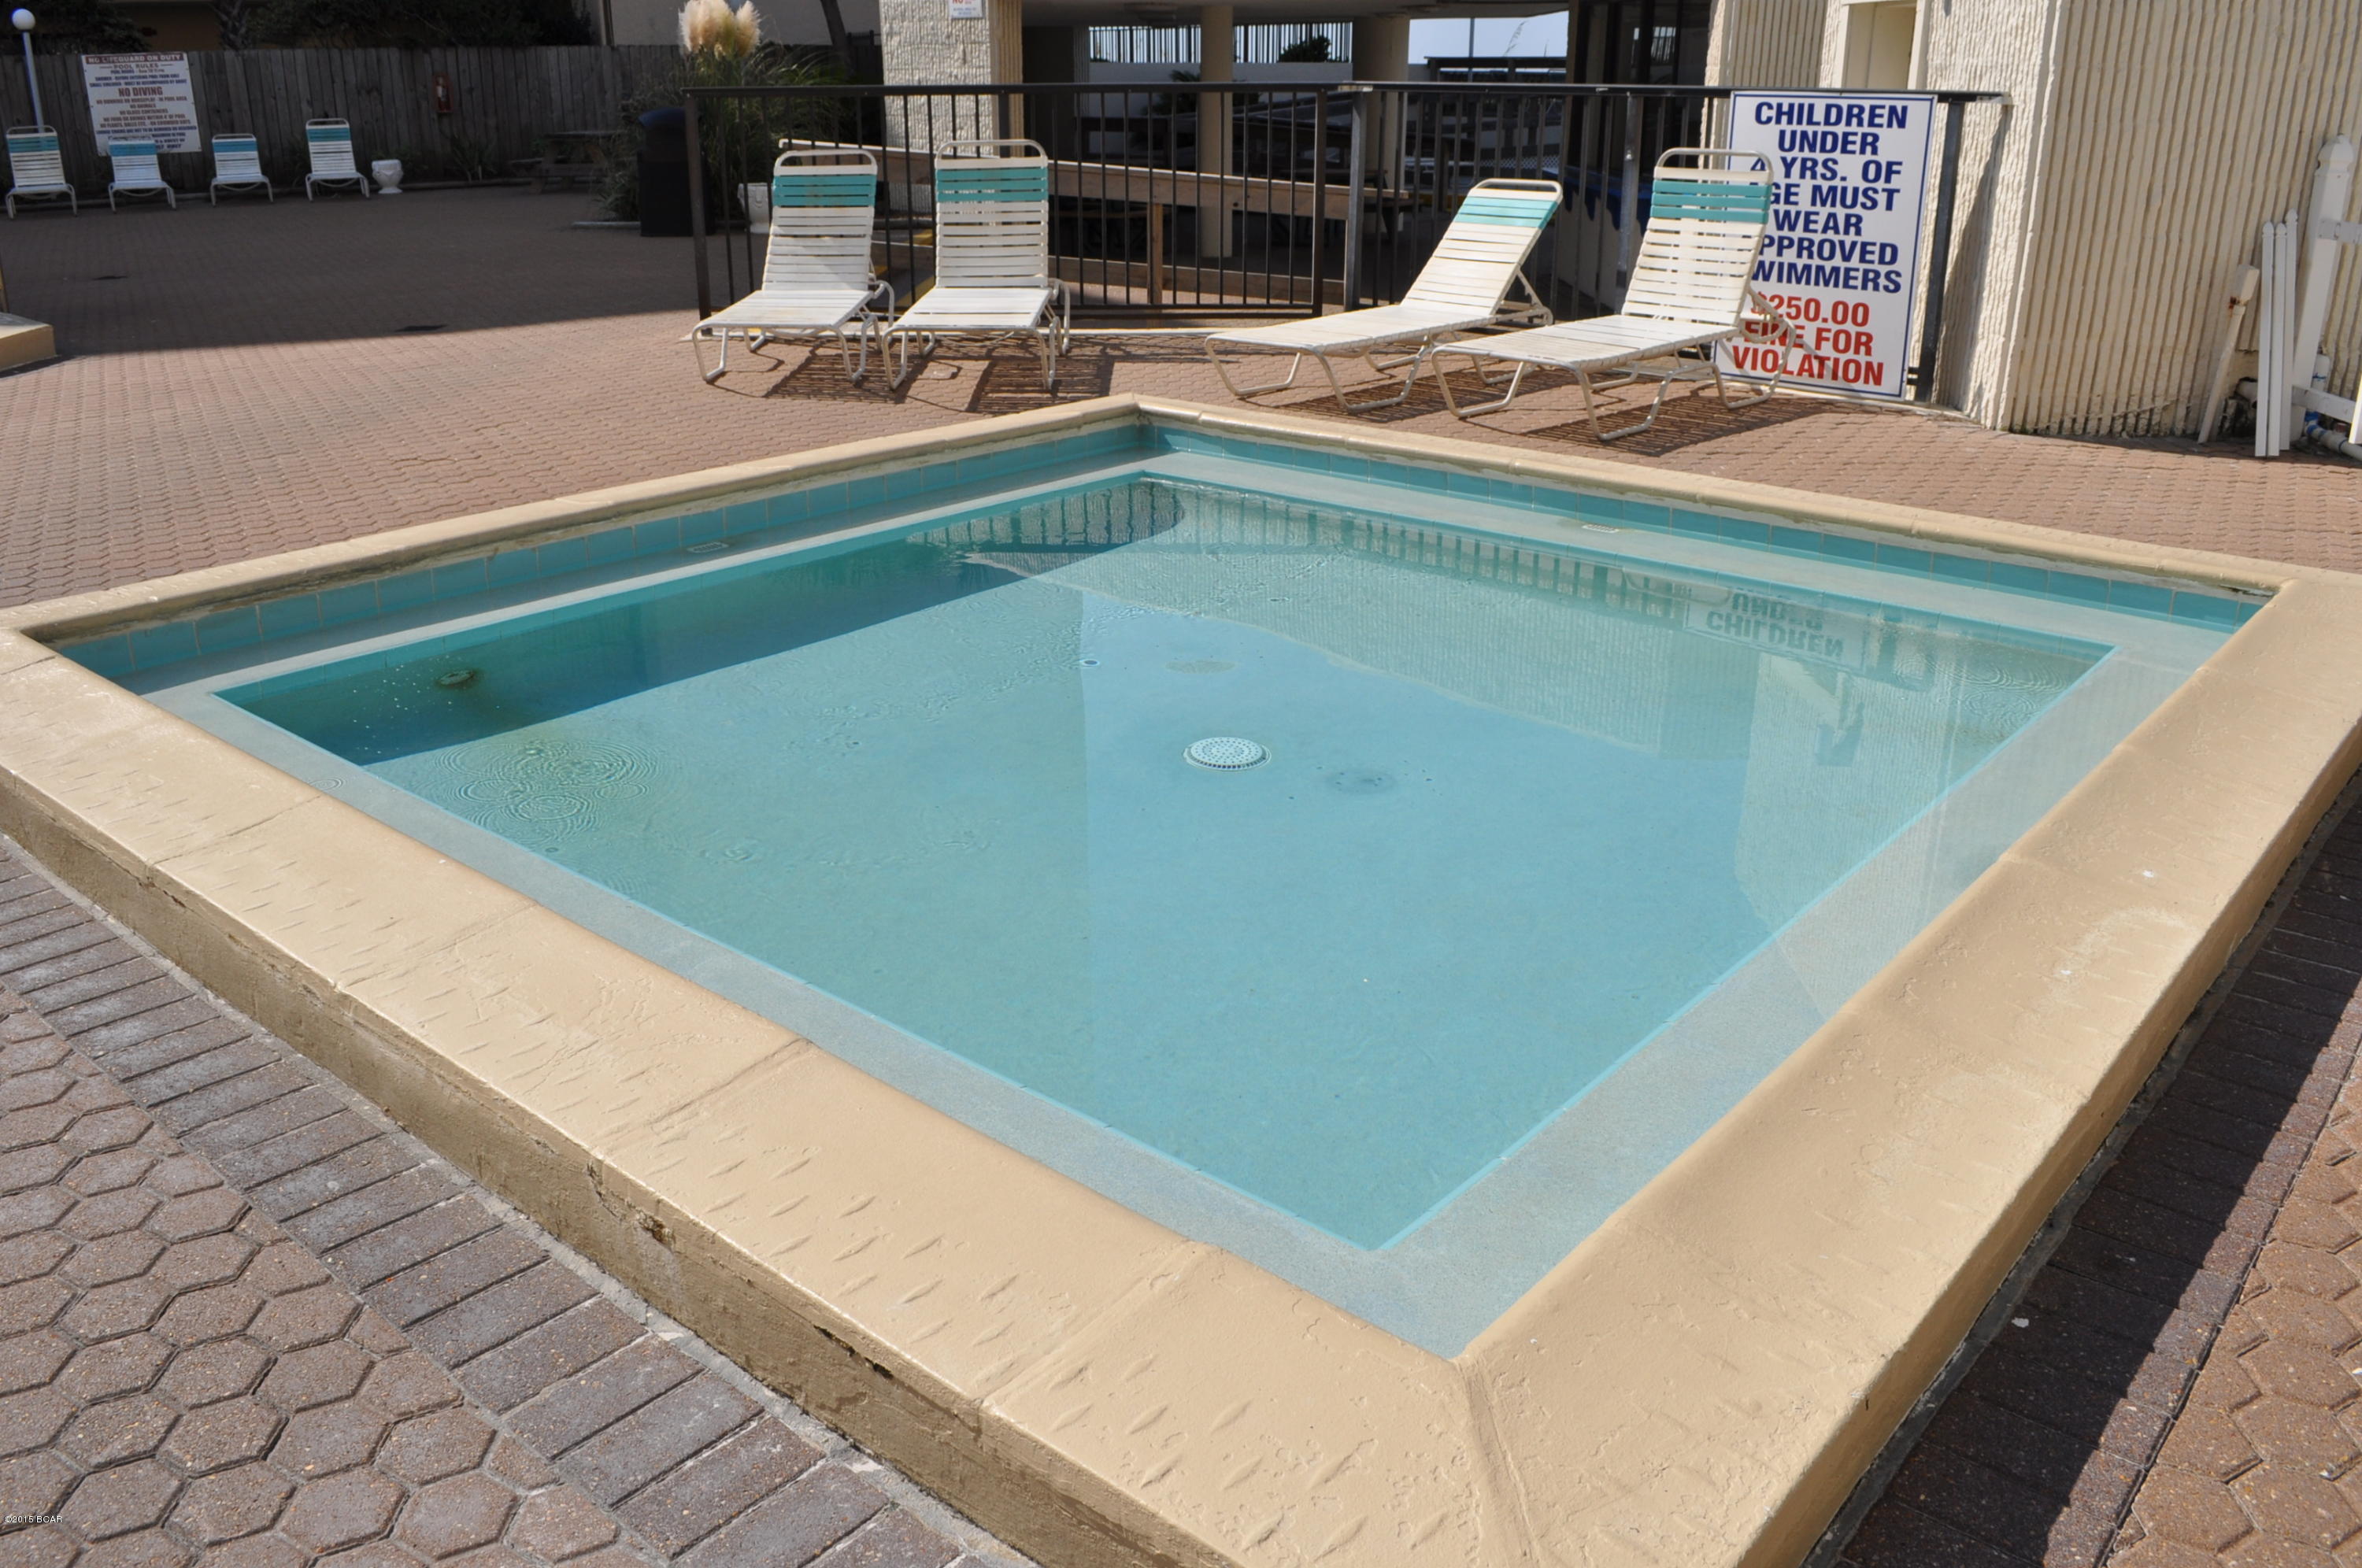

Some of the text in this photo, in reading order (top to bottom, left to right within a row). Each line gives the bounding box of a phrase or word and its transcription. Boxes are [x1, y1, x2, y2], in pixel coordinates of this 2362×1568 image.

[118, 86, 163, 97] NO DIVING
[1754, 101, 1908, 128] CHILDREN
[1778, 130, 1880, 156] UNDER
[1780, 156, 1847, 182] YRS.
[1862, 161, 1903, 184] OF
[1749, 182, 1901, 211] GE MUST
[1773, 209, 1864, 236] WEAR
[1754, 235, 1898, 265] PPROVED
[1746, 260, 1902, 294] WIMMERS
[1814, 327, 1874, 357] FOR
[1732, 345, 1883, 386] VIOLATION
